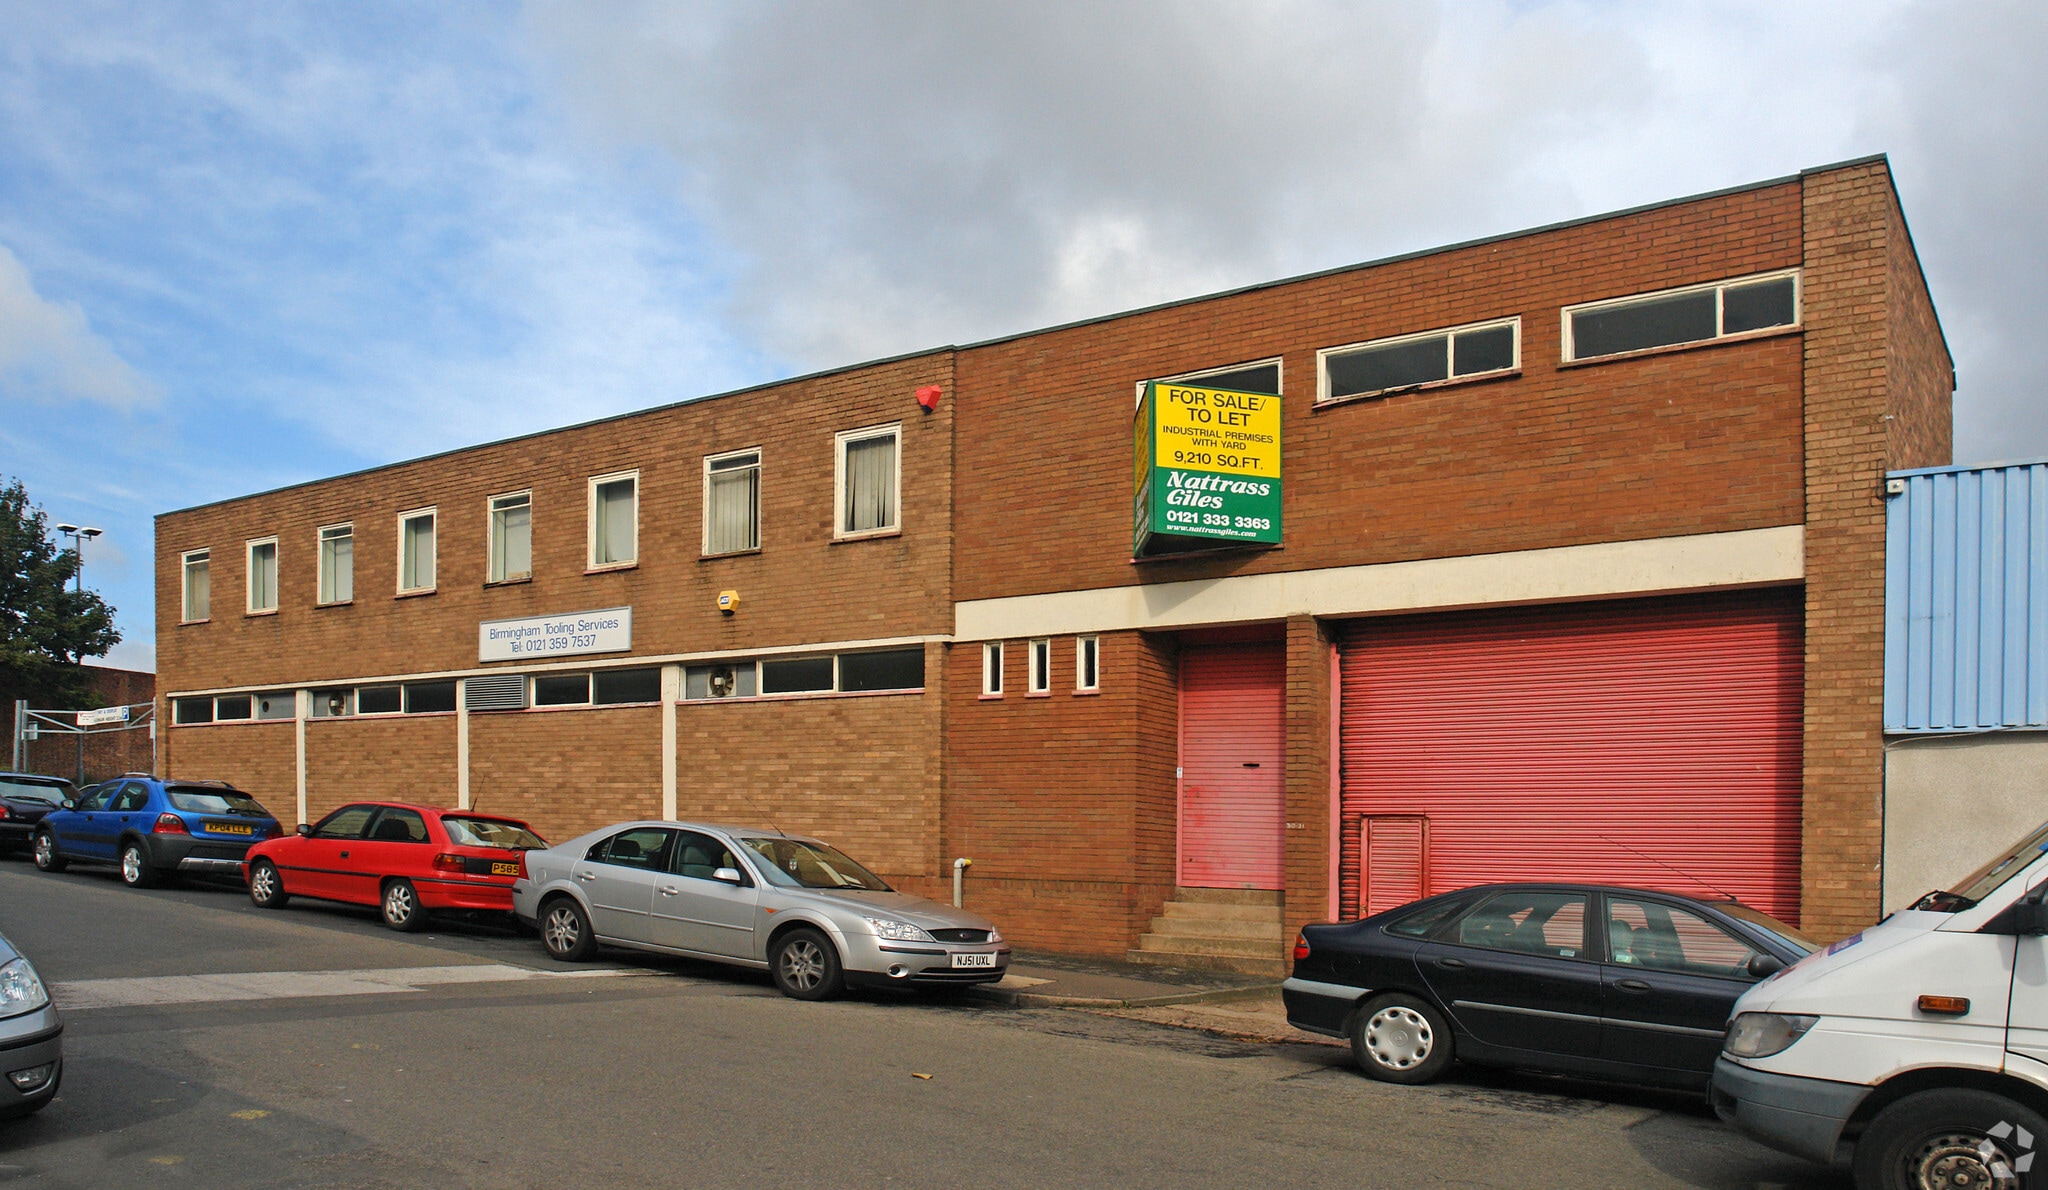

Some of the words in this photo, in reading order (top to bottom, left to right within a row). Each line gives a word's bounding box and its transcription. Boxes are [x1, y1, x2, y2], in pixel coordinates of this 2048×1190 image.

[1170, 389, 1206, 406] FOR
[1213, 393, 1267, 411] SALE/
[1187, 408, 1211, 423] TO
[1218, 412, 1251, 427] LET
[1163, 425, 1221, 438] INDUSTRIAL
[1225, 431, 1274, 444] PREMISES
[1192, 437, 1217, 448] WITH
[1221, 440, 1247, 450] YARD
[1174, 450, 1212, 465] 9,210
[1217, 455, 1264, 470] SQ.FT.
[1166, 471, 1271, 496] Nattrass
[1166, 489, 1224, 509] Giles
[1166, 510, 1198, 524] 0121
[1203, 513, 1230, 526] 333
[1234, 516, 1271, 530] 3363
[1166, 524, 1257, 538] www.nattrassgiles.com
[489, 626, 541, 641] Birmingham
[544, 622, 575, 635] Tooling
[577, 618, 619, 632] Services
[526, 639, 547, 652] 0121
[549, 637, 568, 650] 359
[571, 634, 597, 648] 7537
[208, 823, 231, 832] KP04
[232, 824, 249, 833] LLE
[493, 863, 519, 874] P585
[957, 955, 975, 966] NJ51
[975, 955, 991, 966] UXL
